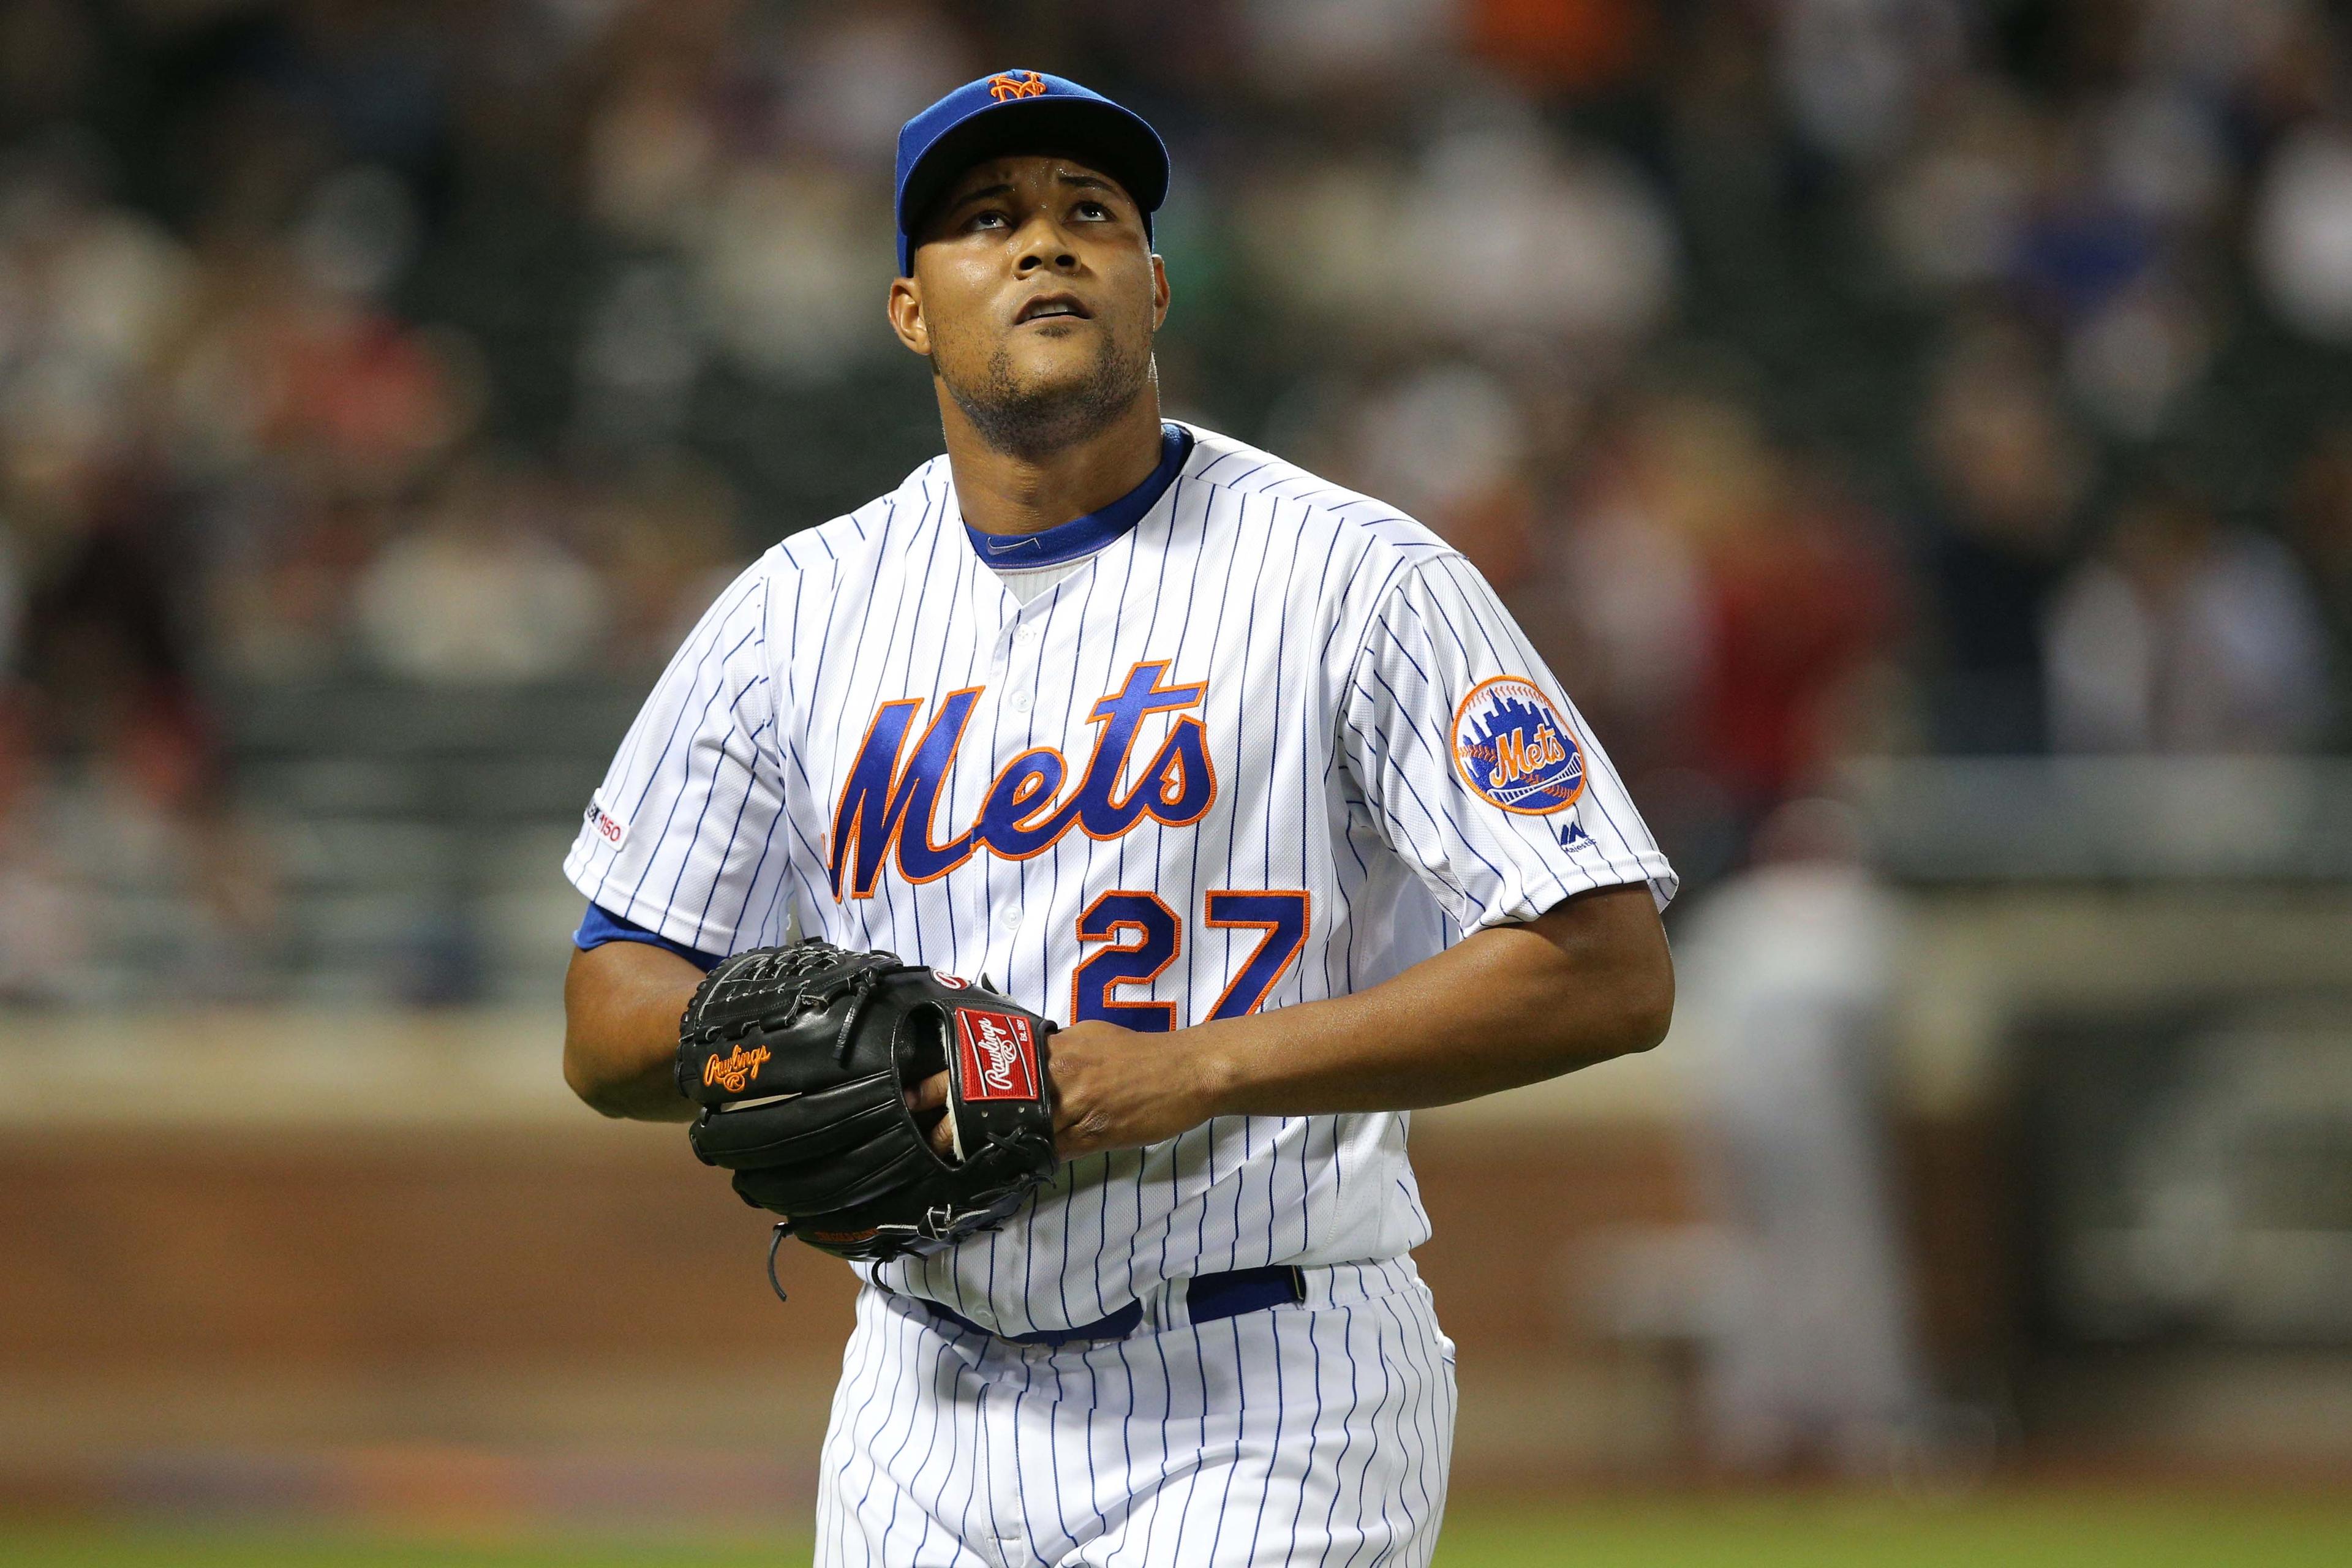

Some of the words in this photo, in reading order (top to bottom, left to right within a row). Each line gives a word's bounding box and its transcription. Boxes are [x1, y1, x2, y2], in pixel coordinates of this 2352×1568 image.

[823, 660, 1217, 902] Mets
[1490, 723, 1566, 788] Mets
[1070, 890, 1310, 1032] 27
[703, 1044, 771, 1087] Rawlings
[978, 1017, 1012, 1090] Rawlings
